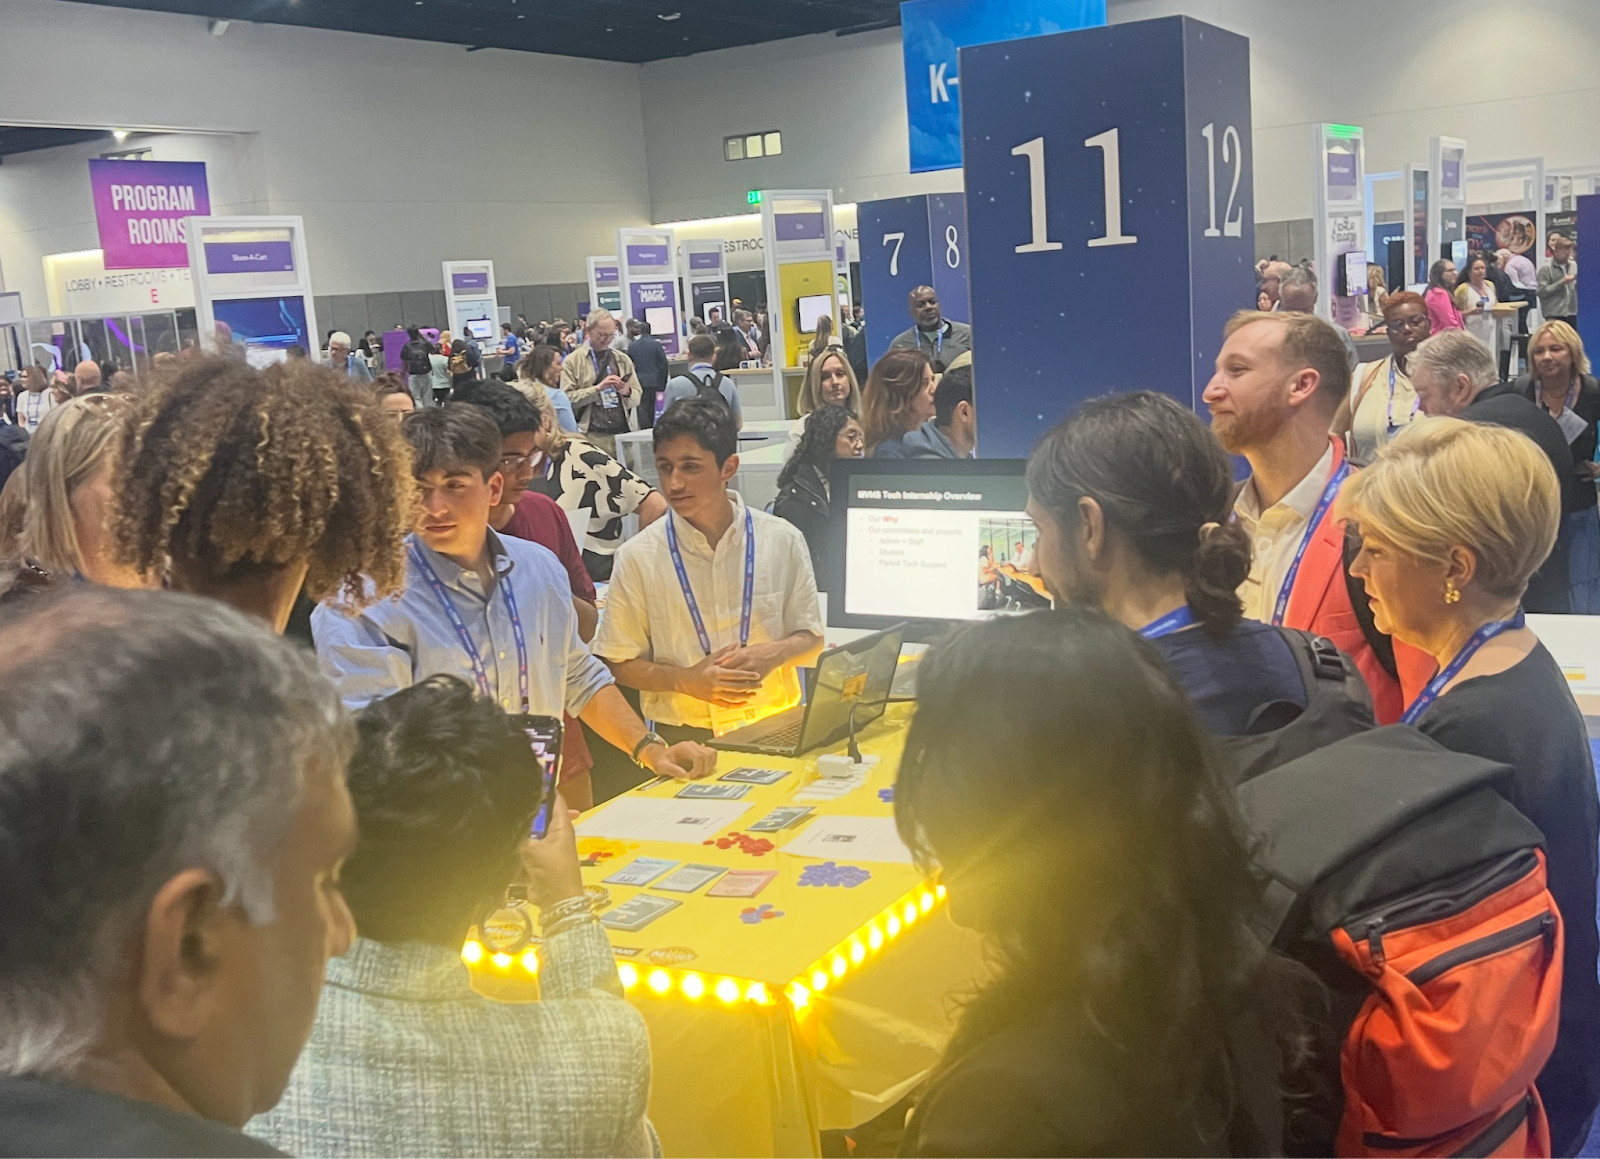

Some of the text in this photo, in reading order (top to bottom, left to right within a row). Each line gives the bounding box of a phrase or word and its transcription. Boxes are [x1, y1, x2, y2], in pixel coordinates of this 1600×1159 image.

[1201, 122, 1242, 238] 12
[110, 184, 195, 211] PROGRAM
[1011, 127, 1138, 254] 11
[127, 217, 187, 244] ROOMS
[882, 231, 905, 276] 7
[945, 224, 960, 269] 8
[66, 277, 97, 292] LOBBY
[104, 270, 168, 289] RESTROOMS
[150, 288, 159, 303] E
[882, 491, 901, 500] Tech
[903, 491, 942, 501] Internship
[943, 491, 982, 501] Overview
[868, 515, 898, 524] Our Why
[879, 537, 900, 545] Admin
[908, 537, 924, 545] Staff
[882, 527, 920, 535] committees
[936, 528, 962, 537] projects
[879, 548, 905, 556] Student
[879, 559, 901, 567] Parent
[920, 560, 947, 569] Support
